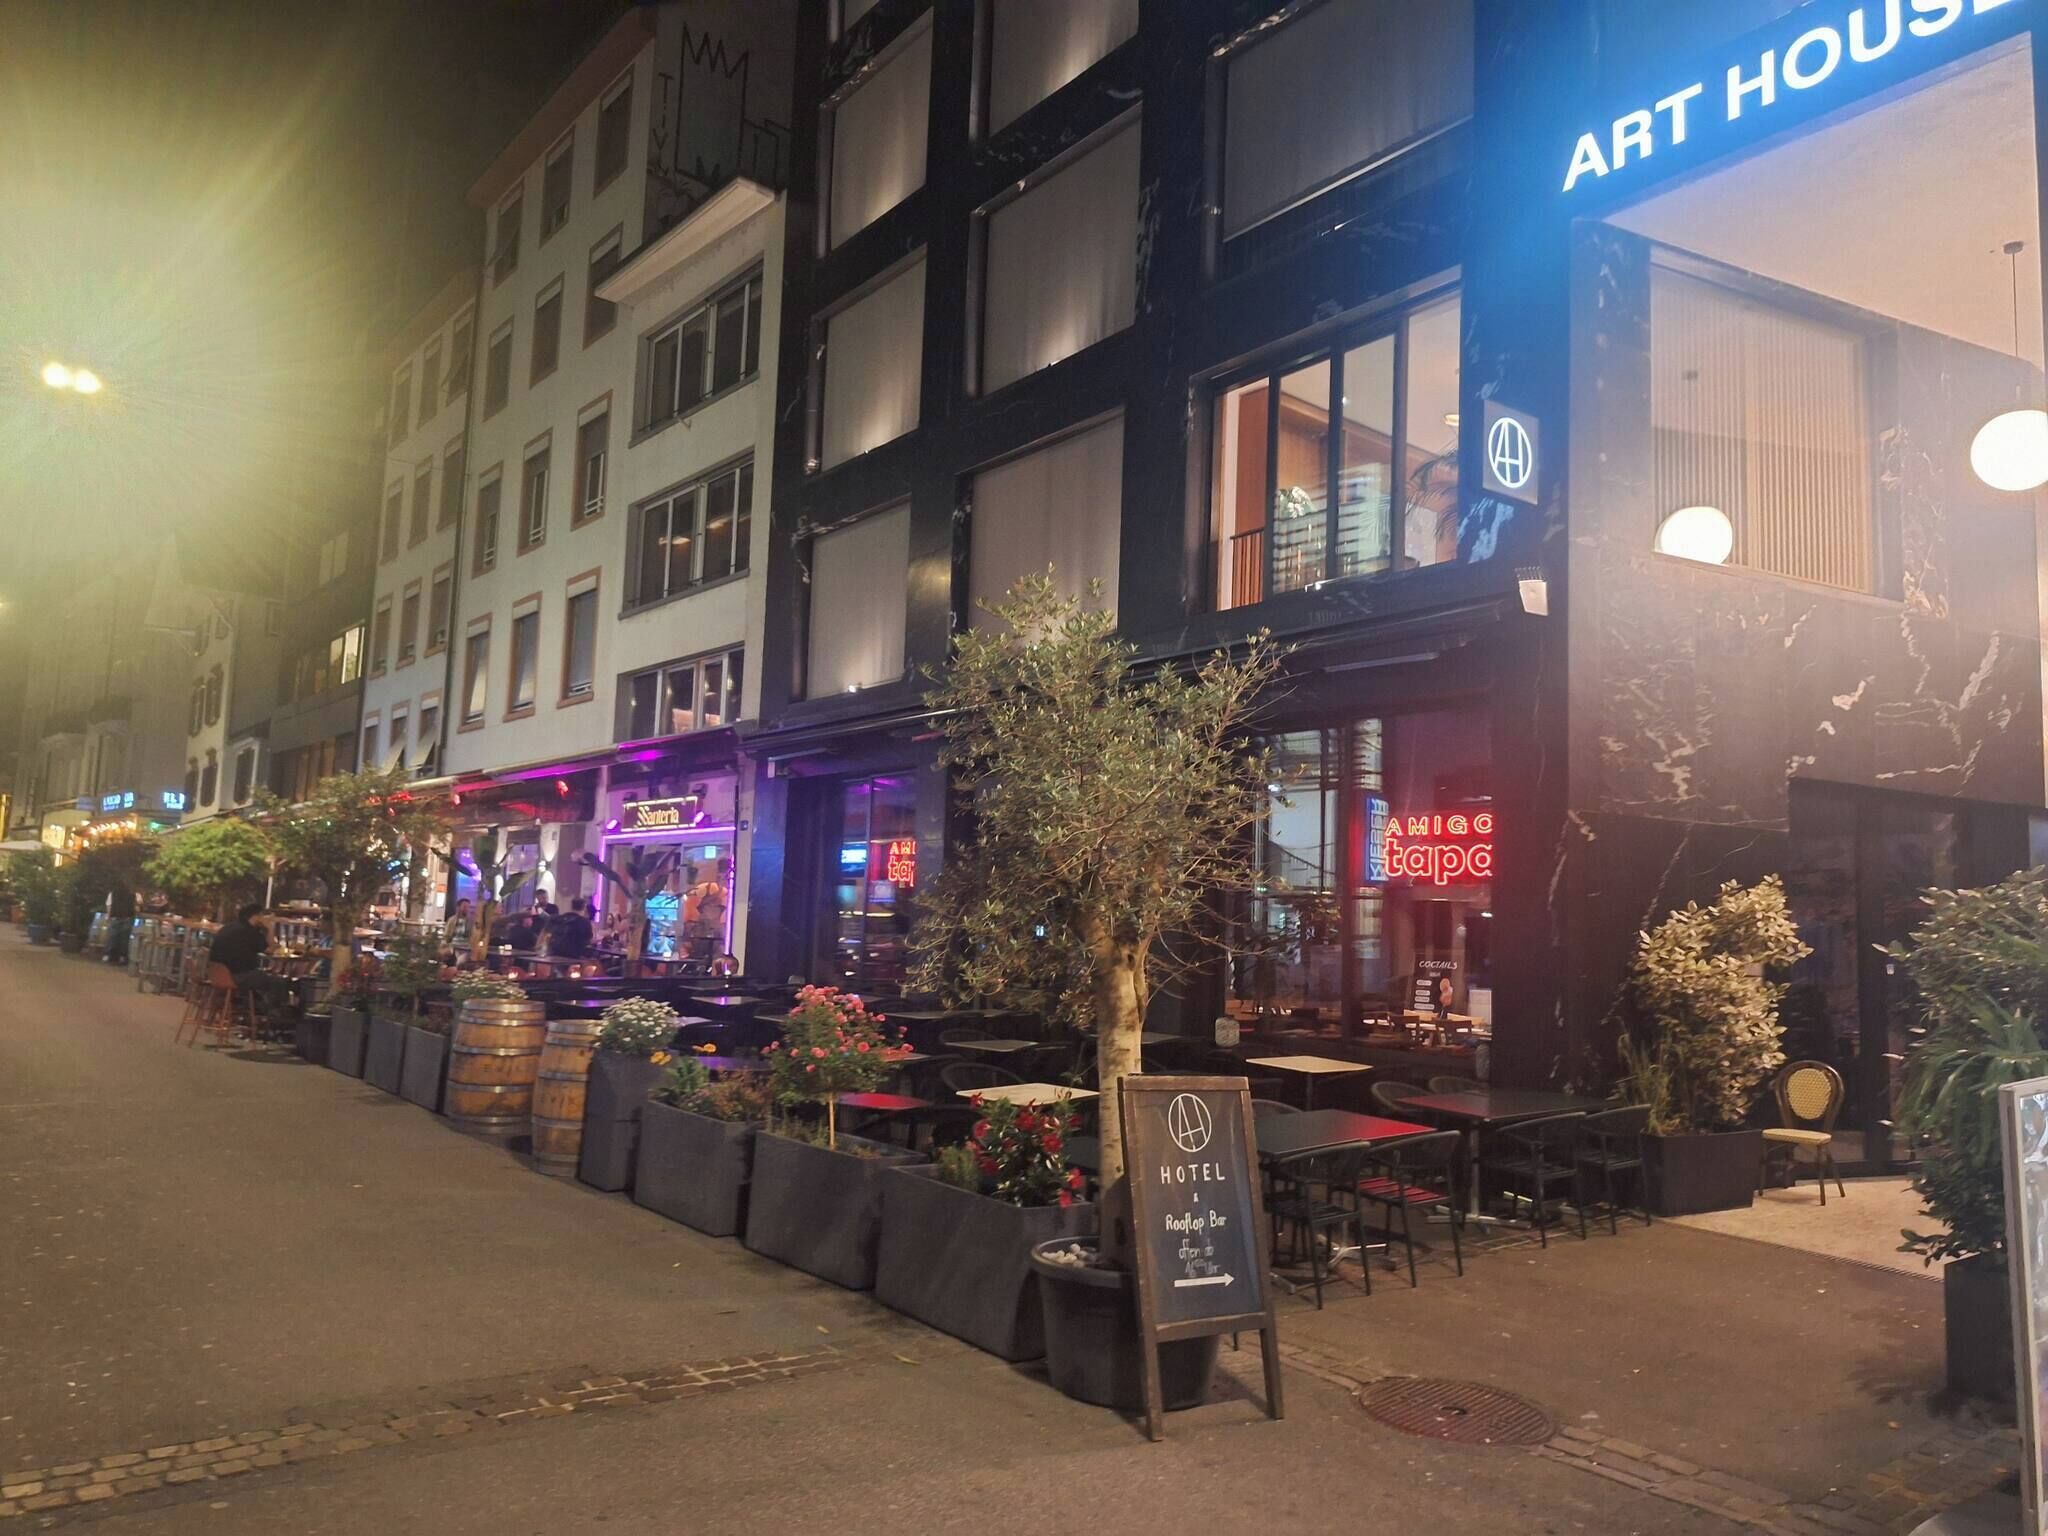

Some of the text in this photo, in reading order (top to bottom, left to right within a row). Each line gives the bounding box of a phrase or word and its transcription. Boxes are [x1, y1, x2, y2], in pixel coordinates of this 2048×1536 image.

[1561, 81, 1703, 192] ART
[1160, 1162, 1226, 1184] HOTEL
[1165, 1209, 1228, 1235] Rooftop Bar
